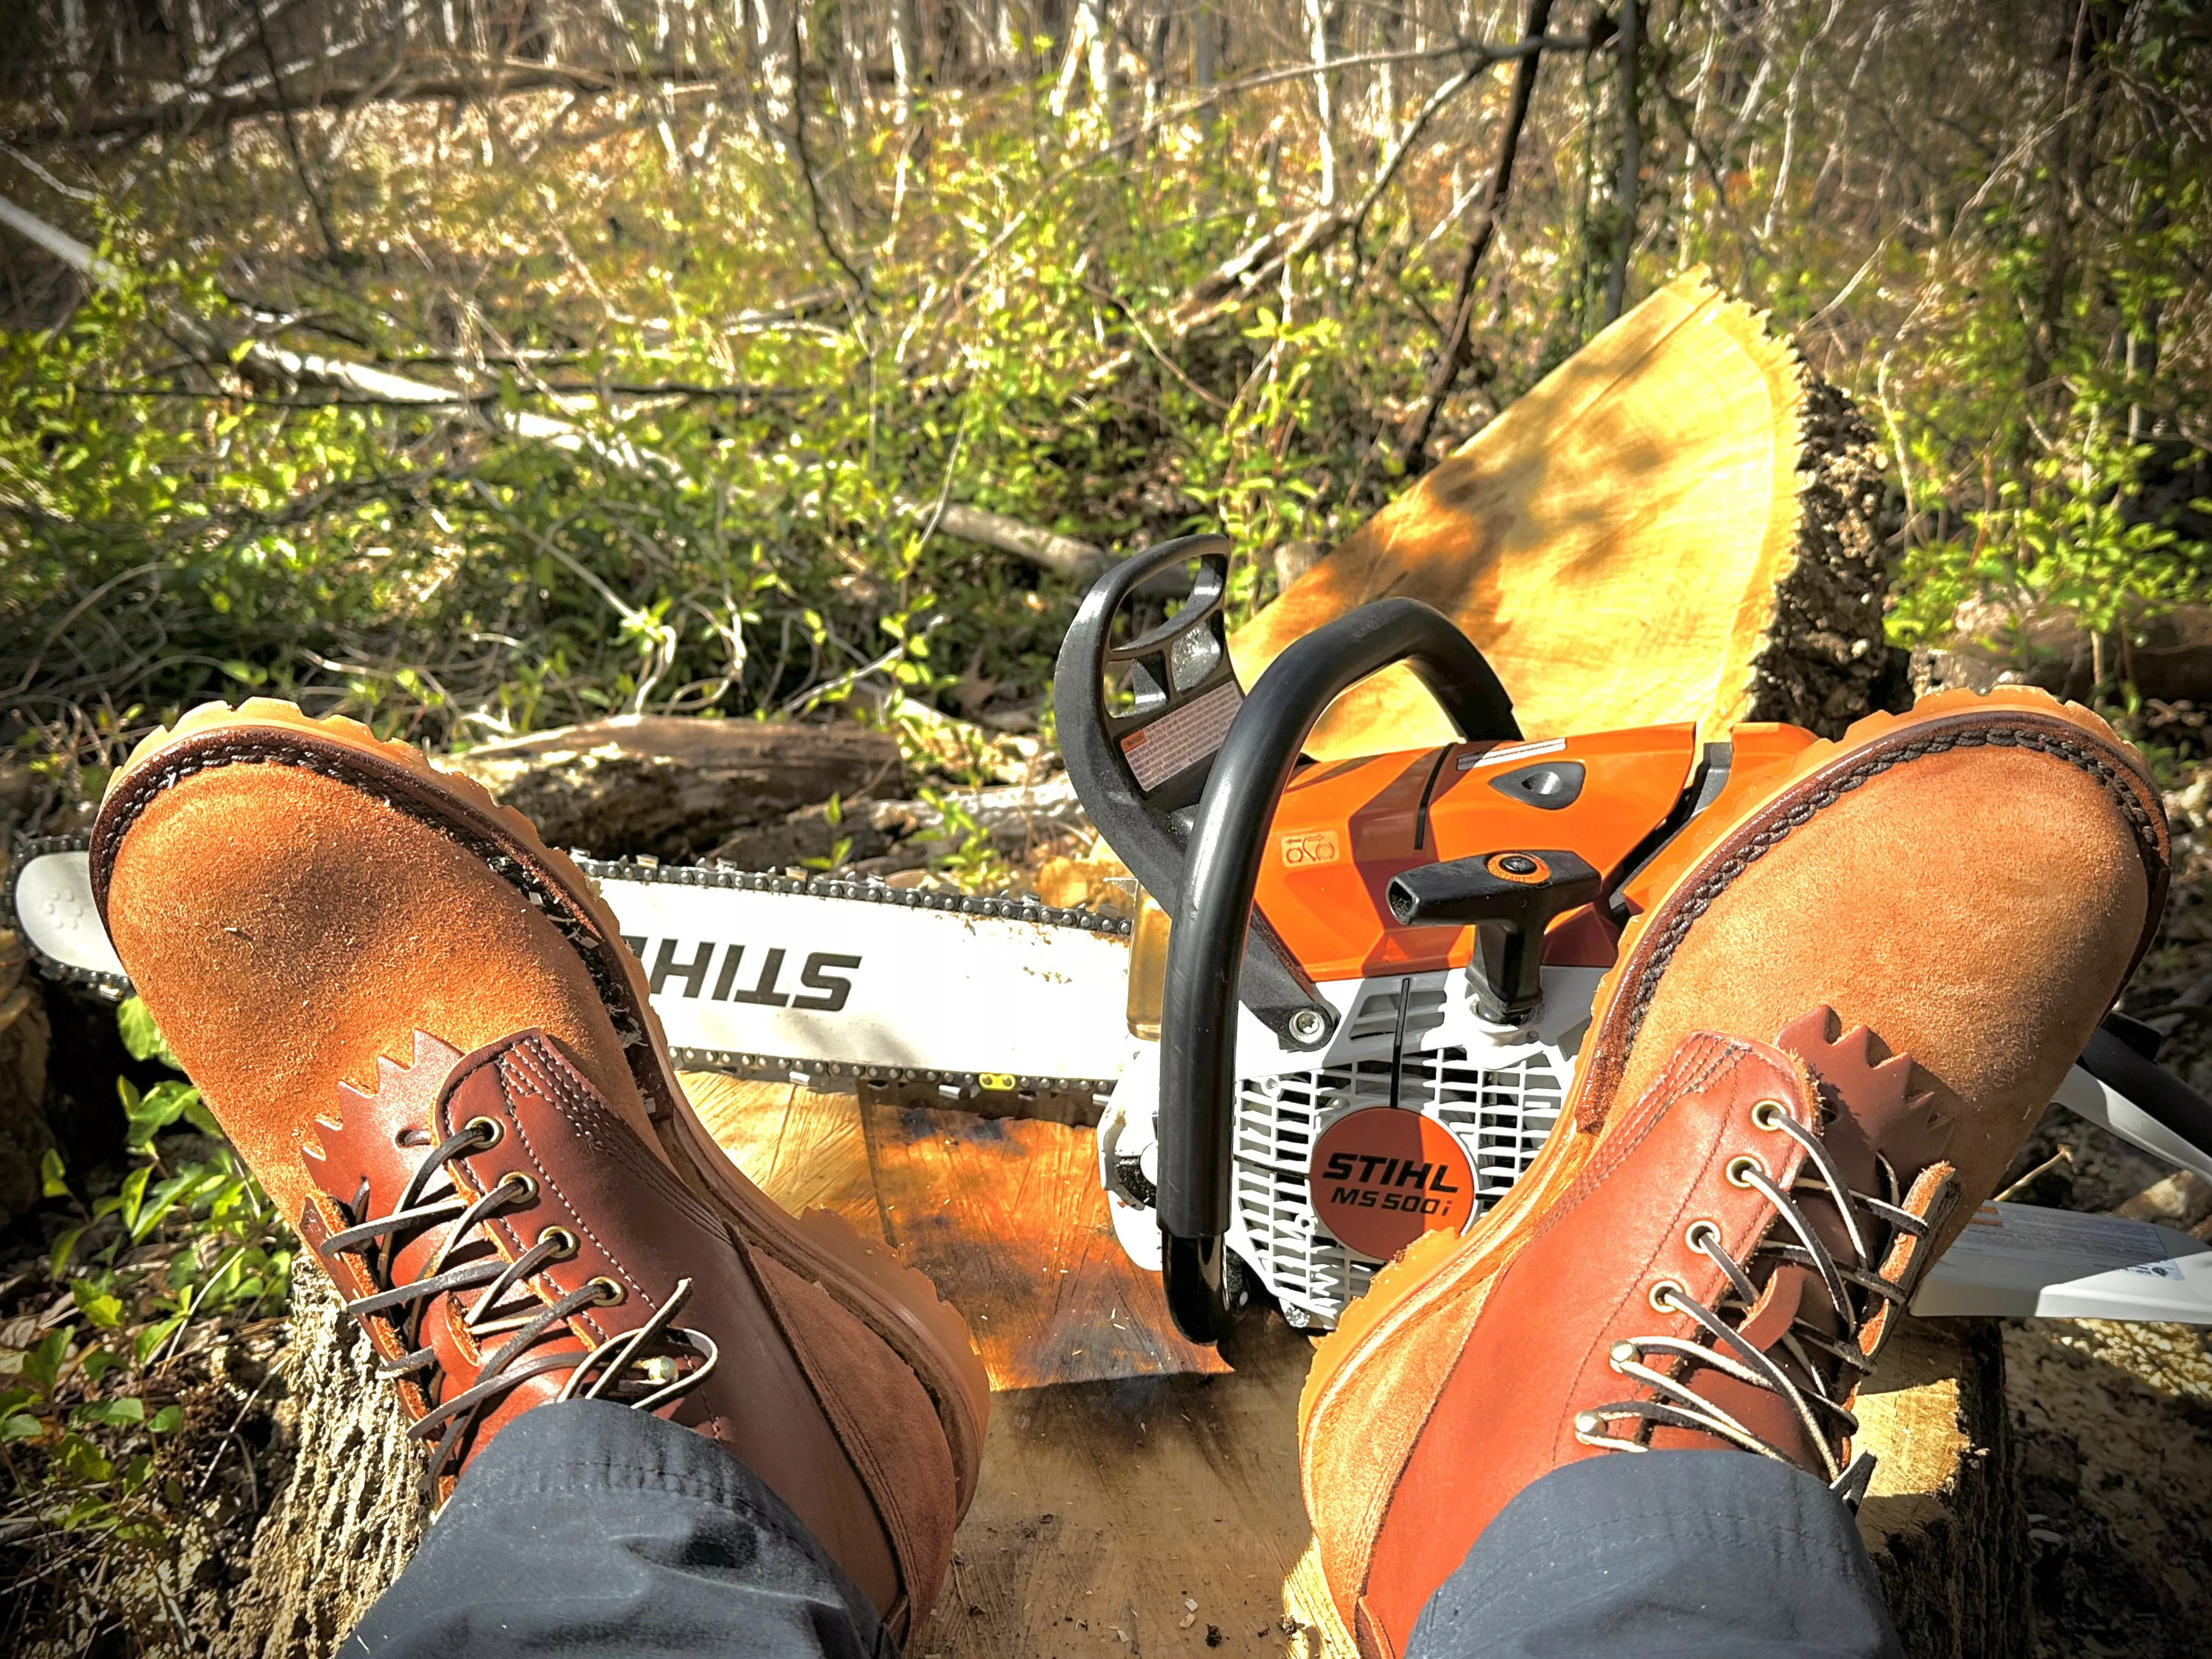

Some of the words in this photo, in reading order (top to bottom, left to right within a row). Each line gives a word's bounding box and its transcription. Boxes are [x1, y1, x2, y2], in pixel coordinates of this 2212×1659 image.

[1322, 1153, 1459, 1193] STIHL
[1330, 1187, 1380, 1208] MS
[1381, 1193, 1452, 1217] 500i
